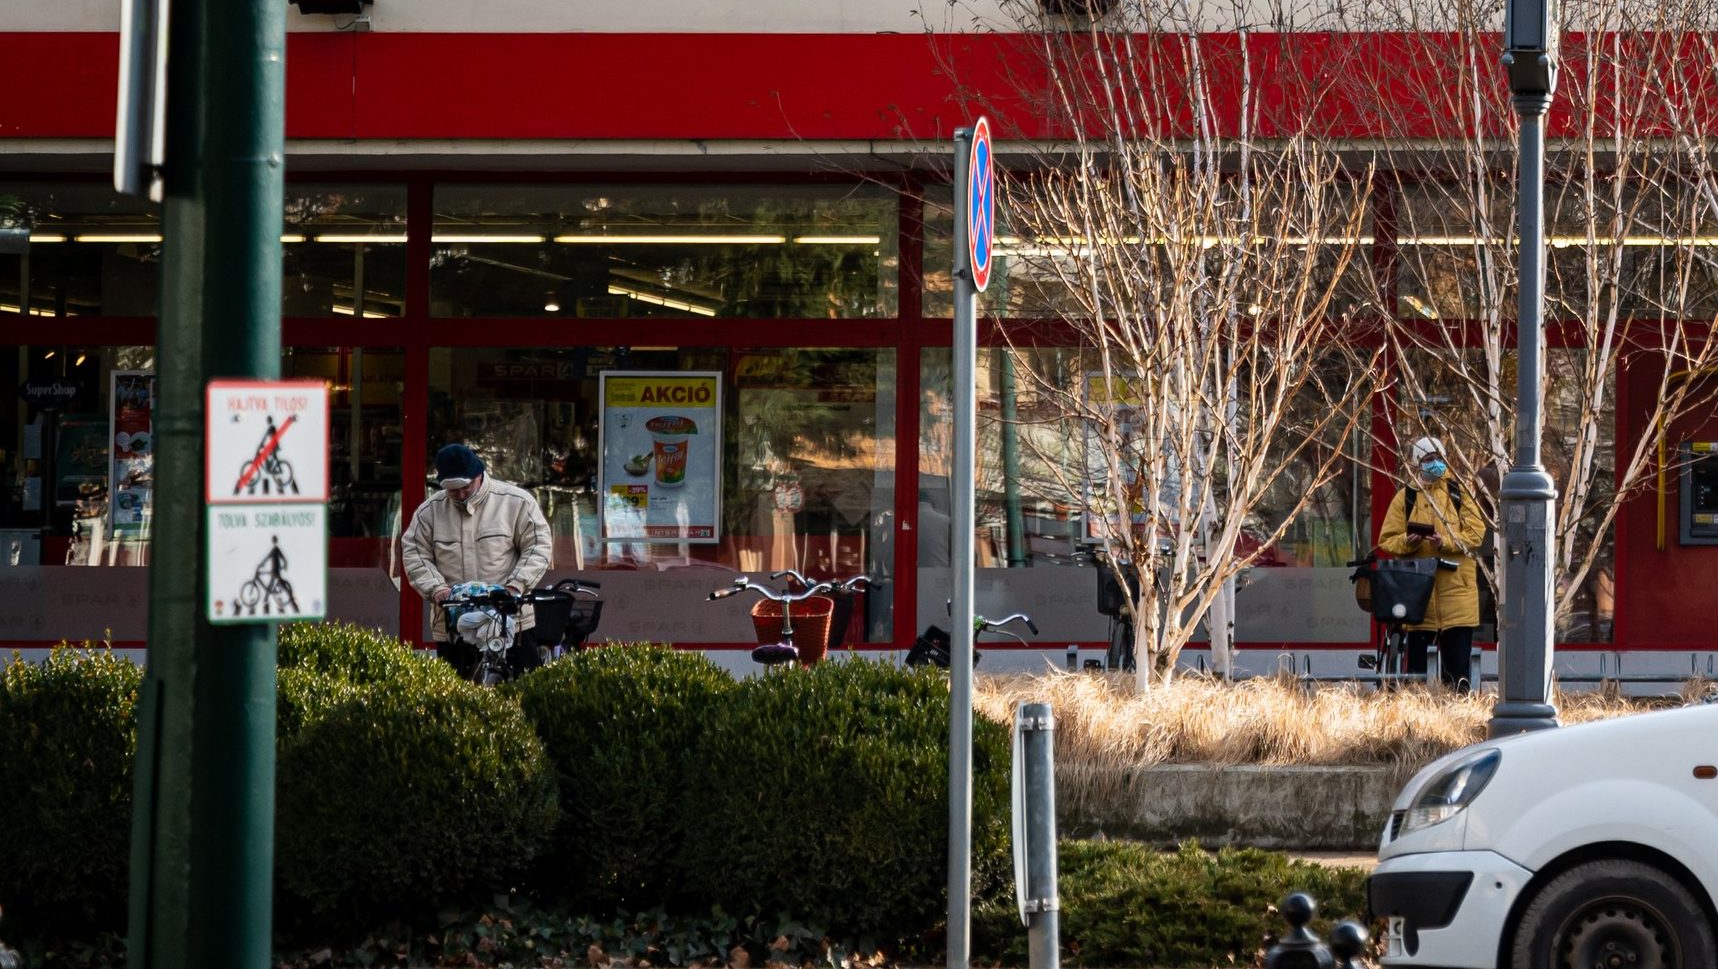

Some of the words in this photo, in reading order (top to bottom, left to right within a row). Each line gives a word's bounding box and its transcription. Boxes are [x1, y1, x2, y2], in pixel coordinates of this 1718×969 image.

[26, 383, 76, 396] SuperShop
[640, 382, 711, 403] AKCIÓ
[218, 513, 249, 528] TOLVA
[255, 511, 315, 528] SZABÁLYOS!
